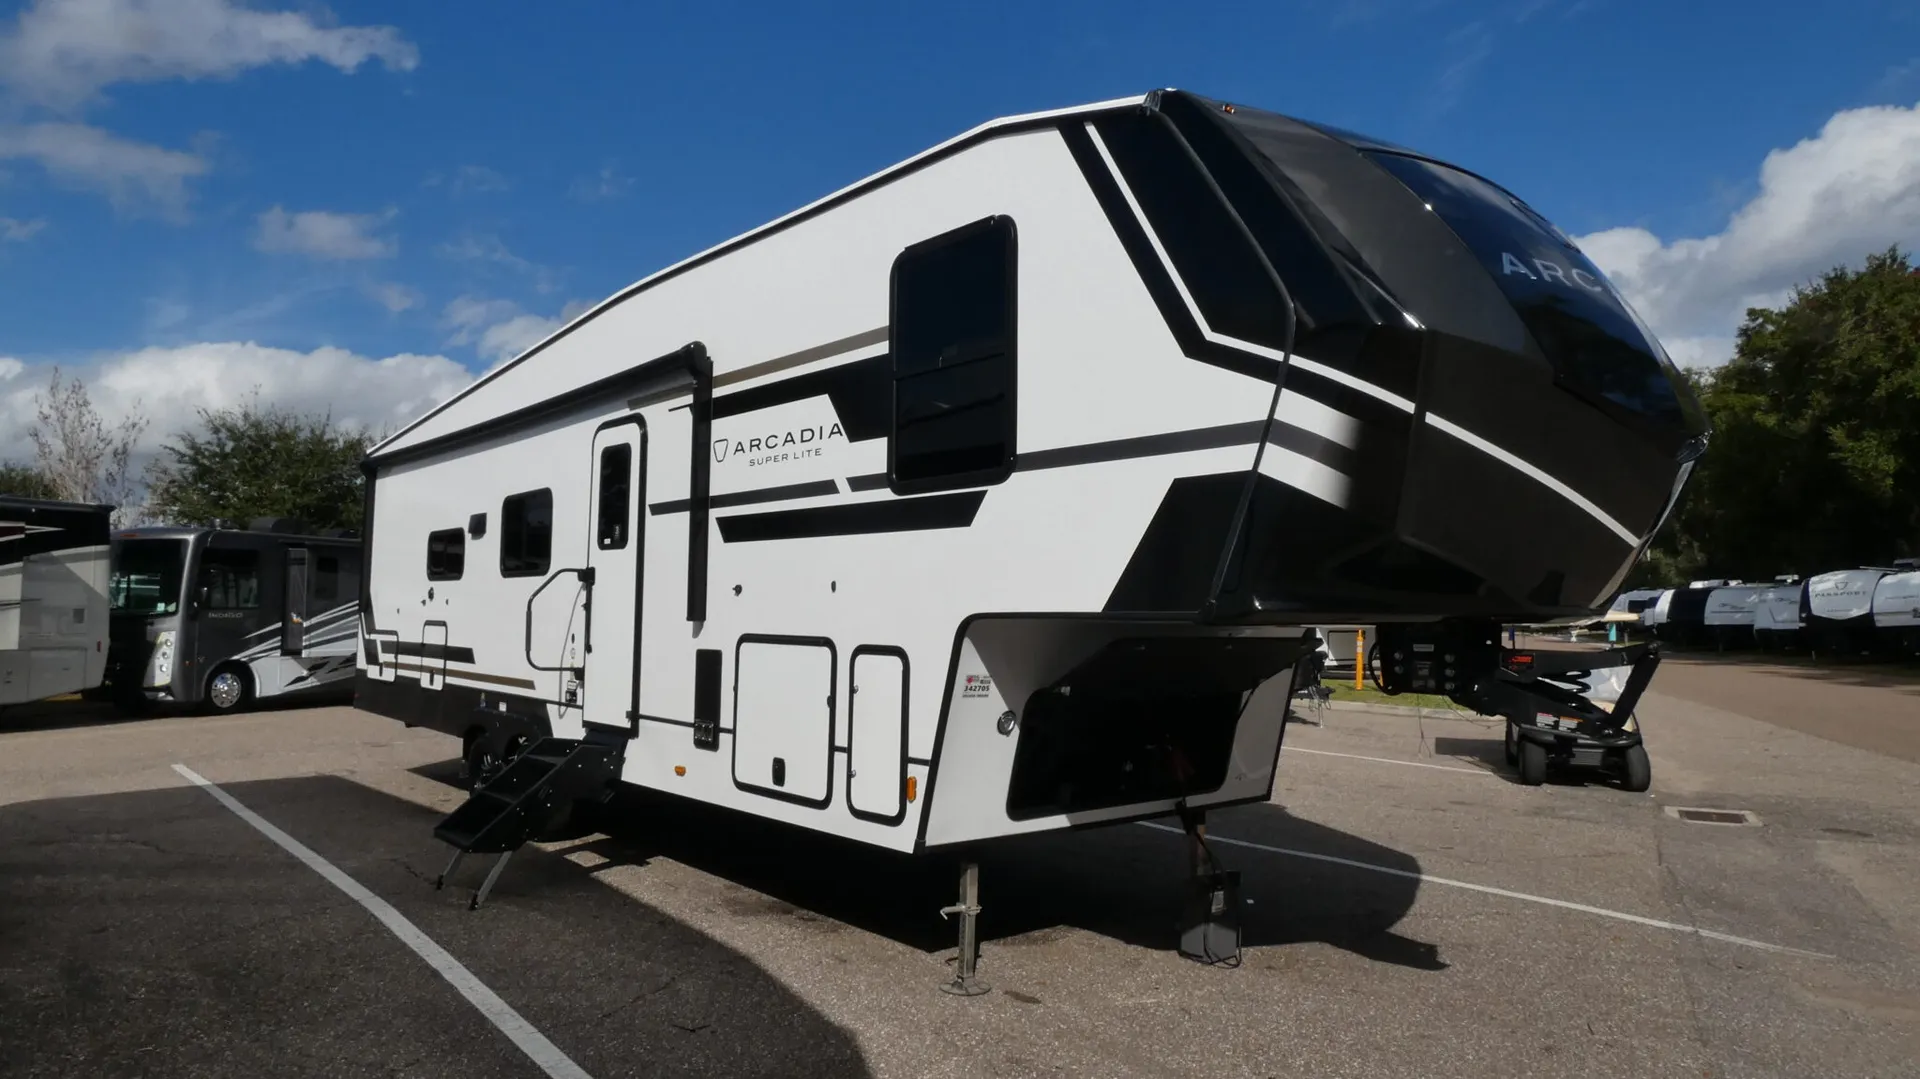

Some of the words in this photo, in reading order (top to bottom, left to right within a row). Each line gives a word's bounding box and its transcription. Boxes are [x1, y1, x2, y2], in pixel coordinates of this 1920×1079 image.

[733, 423, 843, 456] ARCADIA
[749, 453, 789, 466] SUPER
[793, 448, 822, 460] LITE
